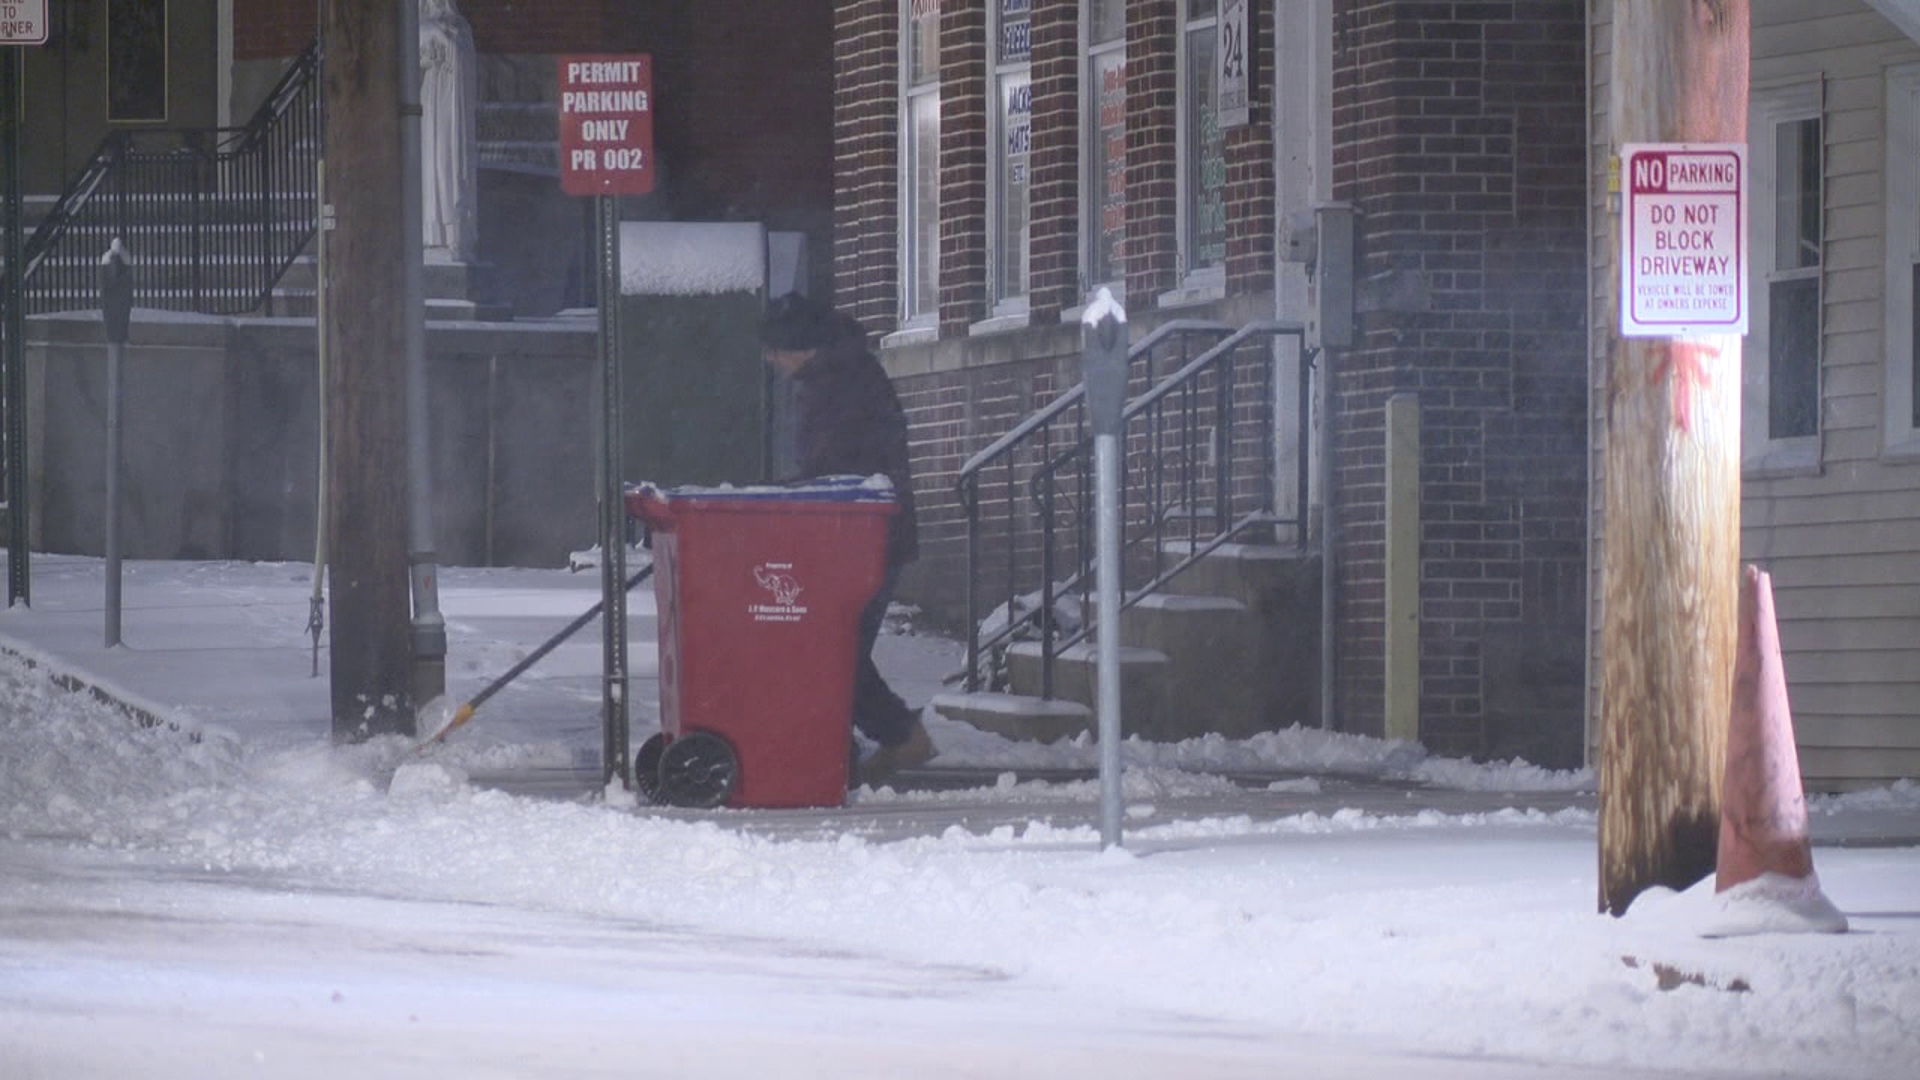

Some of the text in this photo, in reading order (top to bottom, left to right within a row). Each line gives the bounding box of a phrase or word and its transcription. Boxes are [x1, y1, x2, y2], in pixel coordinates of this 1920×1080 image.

[2, 6, 16, 19] TO
[1223, 20, 1243, 78] 24
[568, 61, 641, 84] PERMIT
[563, 90, 648, 113] PARKING
[582, 120, 629, 141] ONLY
[1008, 125, 1030, 155] HATS
[571, 148, 643, 171] PR 002
[1635, 159, 1734, 188] NO PARKING
[1651, 205, 1719, 224] DO NOT
[1655, 231, 1714, 250] BLOCK
[1641, 256, 1729, 275] DRIVEWAY
[1638, 284, 1734, 296] VEHICLE WILL BE TOWED
[1645, 298, 1727, 309] AT OWNERS EXPENSE
